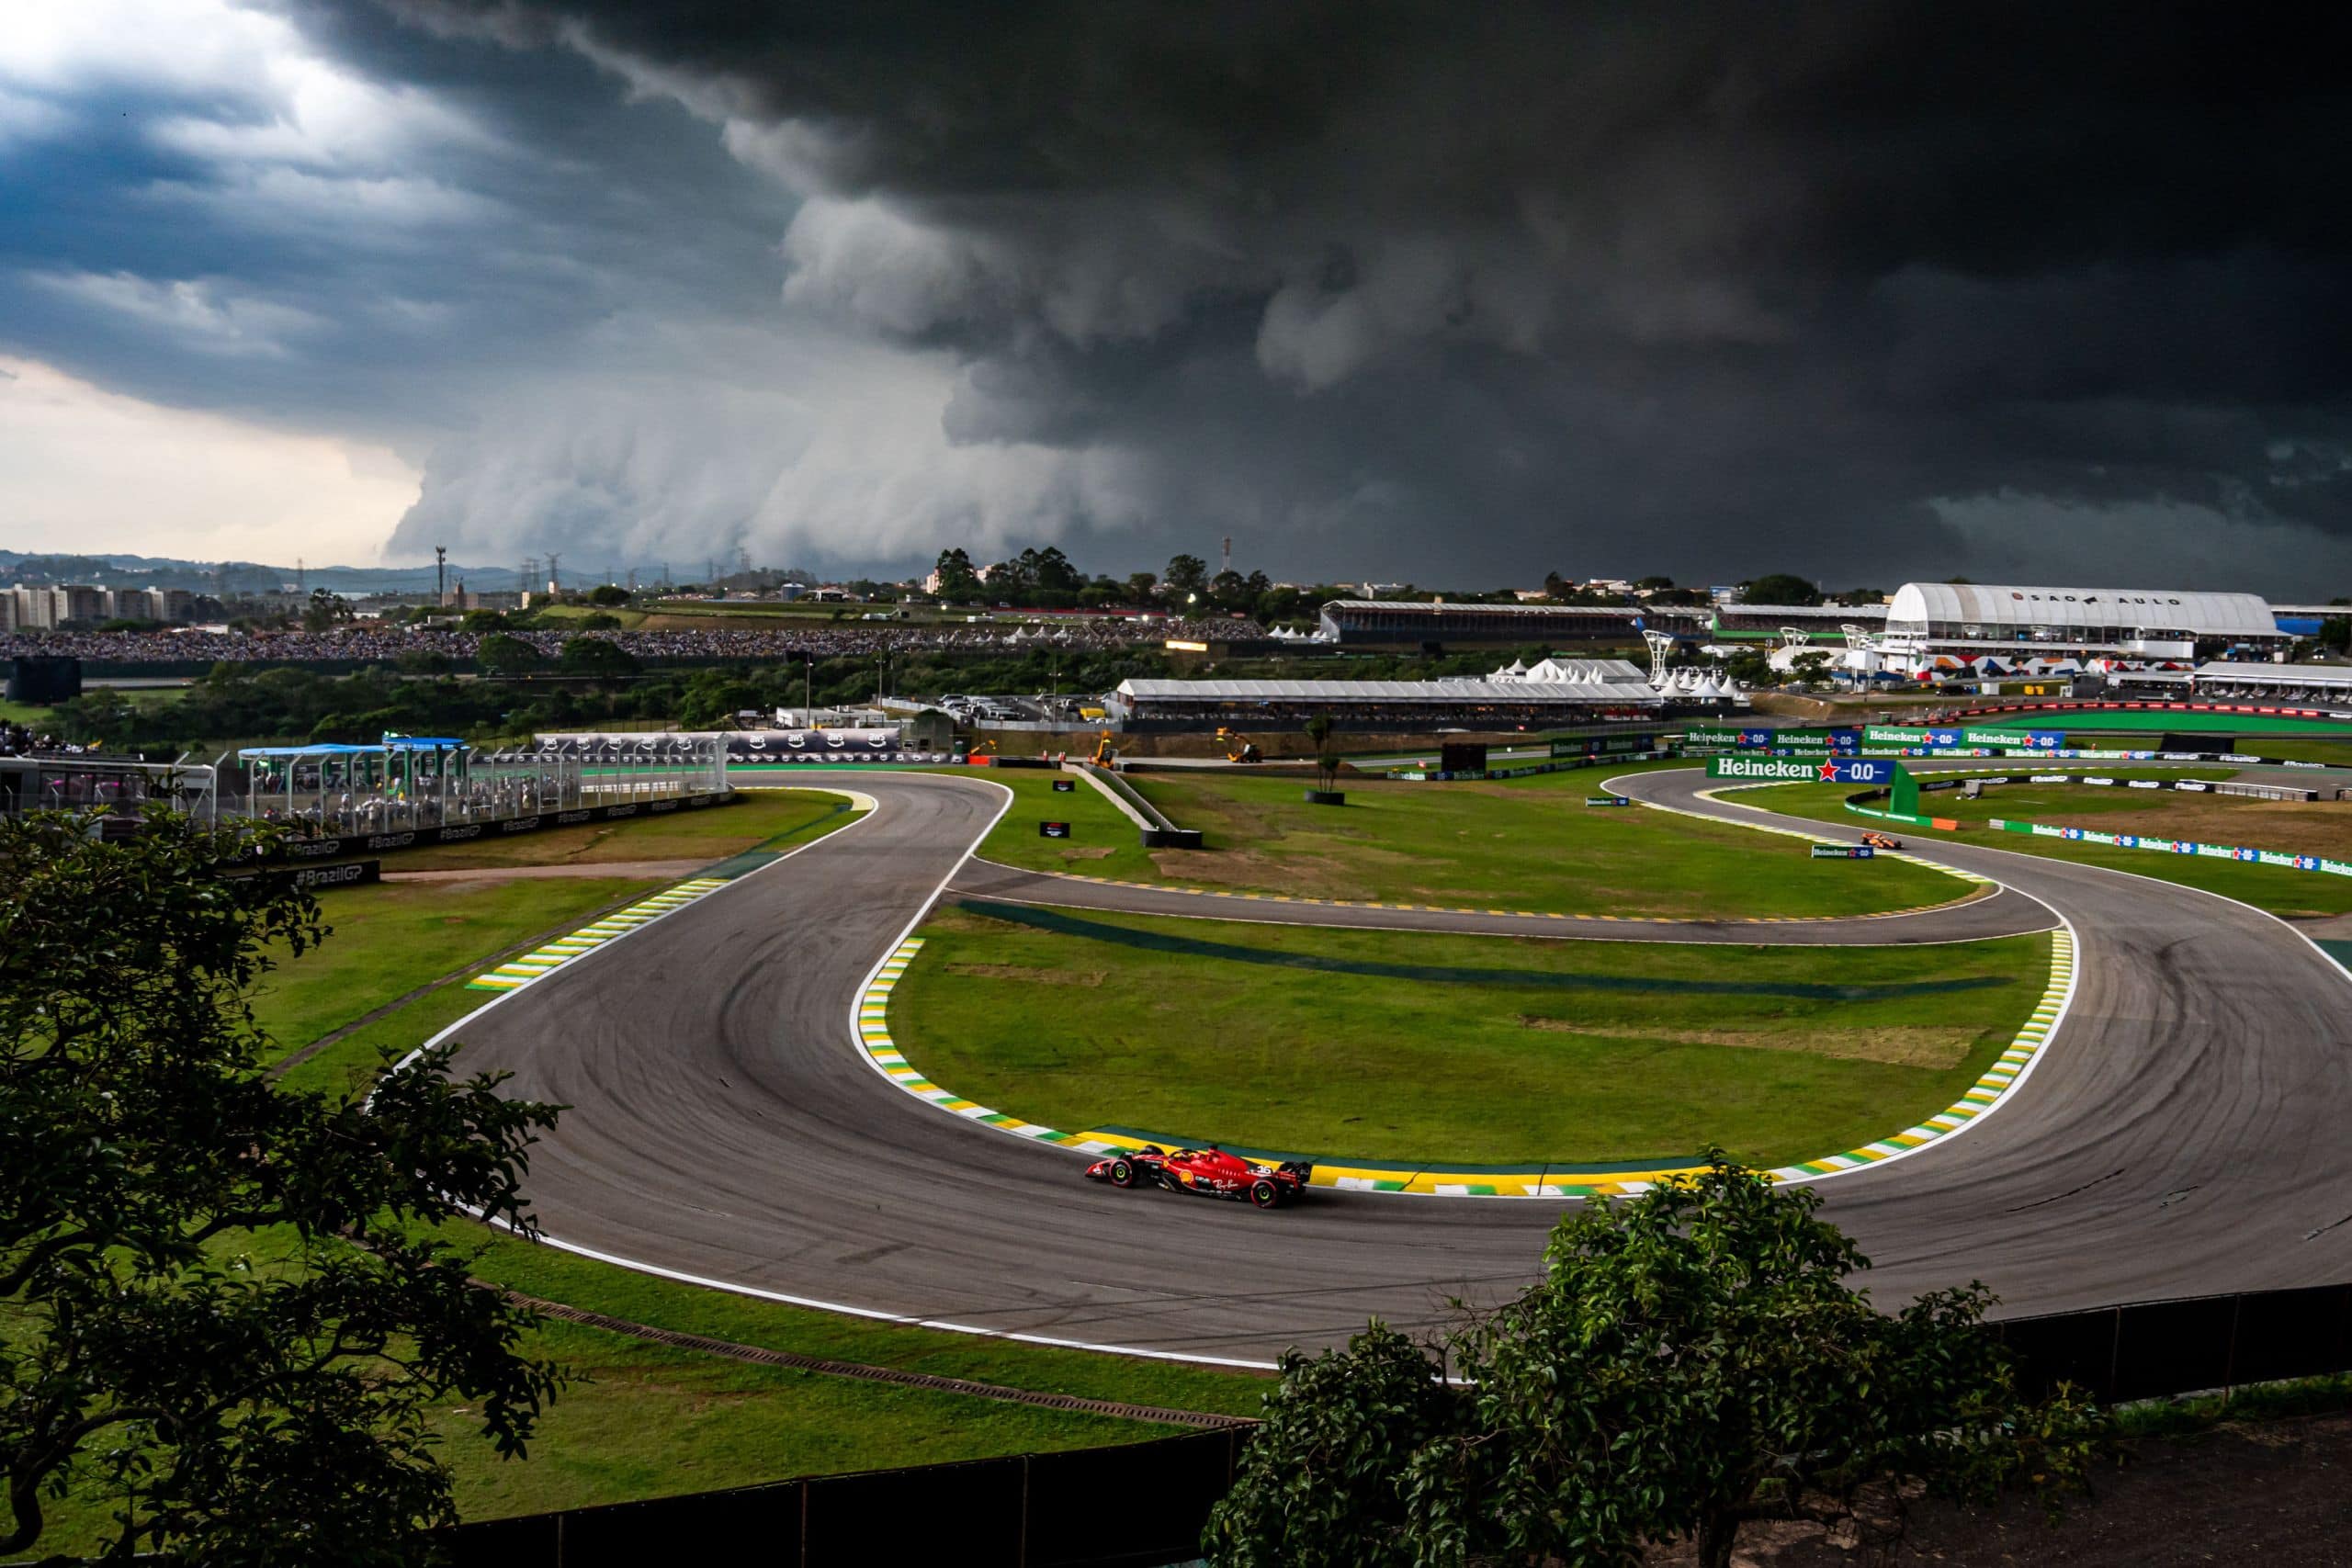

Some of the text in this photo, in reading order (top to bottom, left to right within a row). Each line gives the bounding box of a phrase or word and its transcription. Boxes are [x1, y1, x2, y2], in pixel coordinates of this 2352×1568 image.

[1778, 734, 1823, 744] Heineken
[1870, 730, 1920, 742] Heineken
[1968, 733, 2020, 745] Heineken
[1718, 758, 1814, 778] Heineken
[296, 865, 363, 886] #BrazilGP
